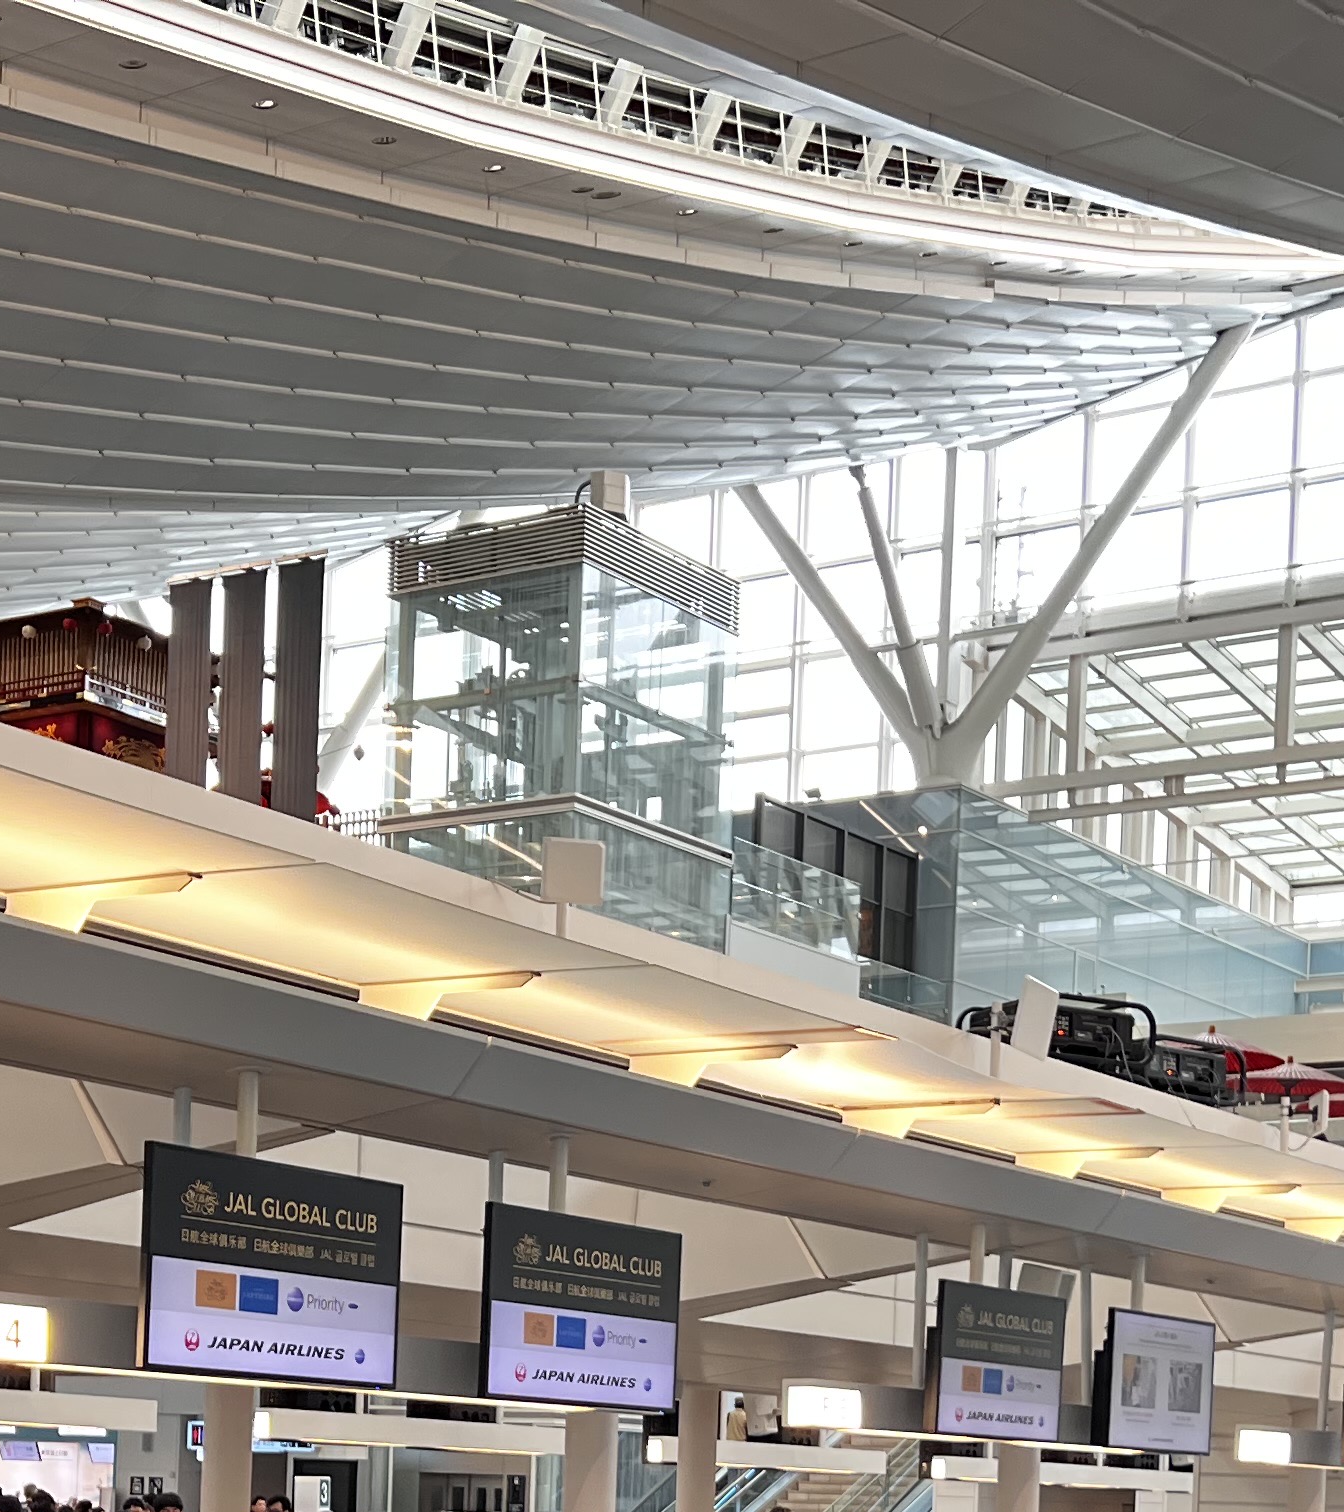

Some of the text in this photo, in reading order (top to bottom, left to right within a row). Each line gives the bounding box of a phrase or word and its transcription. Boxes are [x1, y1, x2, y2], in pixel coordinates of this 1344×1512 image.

[224, 1191, 378, 1234] JAL GLOBAL CLUB
[545, 1243, 663, 1278] JAL GLOBAL CLUB
[306, 1293, 345, 1315] Priority
[978, 1310, 1054, 1335] JAL GLOBAL CLUB
[207, 1336, 345, 1361] JAPAN AIRLINES
[532, 1369, 637, 1389] JAPAN AIRLINES
[966, 1410, 1034, 1426] JAPAN AIRLINES
[320, 1482, 329, 1504] 3
